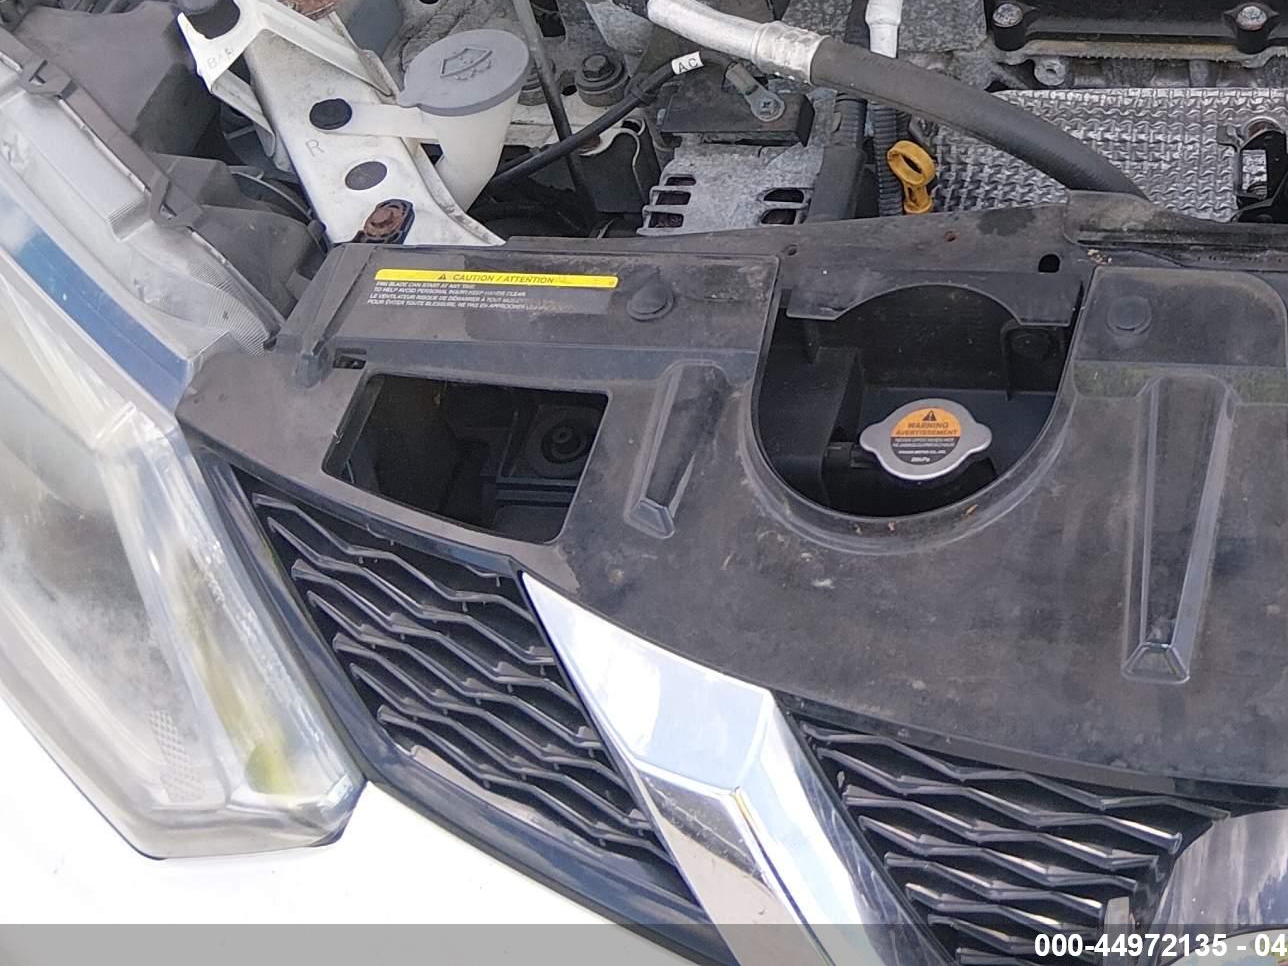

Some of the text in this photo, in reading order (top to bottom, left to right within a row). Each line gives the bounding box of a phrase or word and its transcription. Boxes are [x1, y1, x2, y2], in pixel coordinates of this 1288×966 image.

[678, 57, 699, 73] AC
[453, 273, 495, 282] CAUTION
[502, 275, 554, 284] ATTENTION
